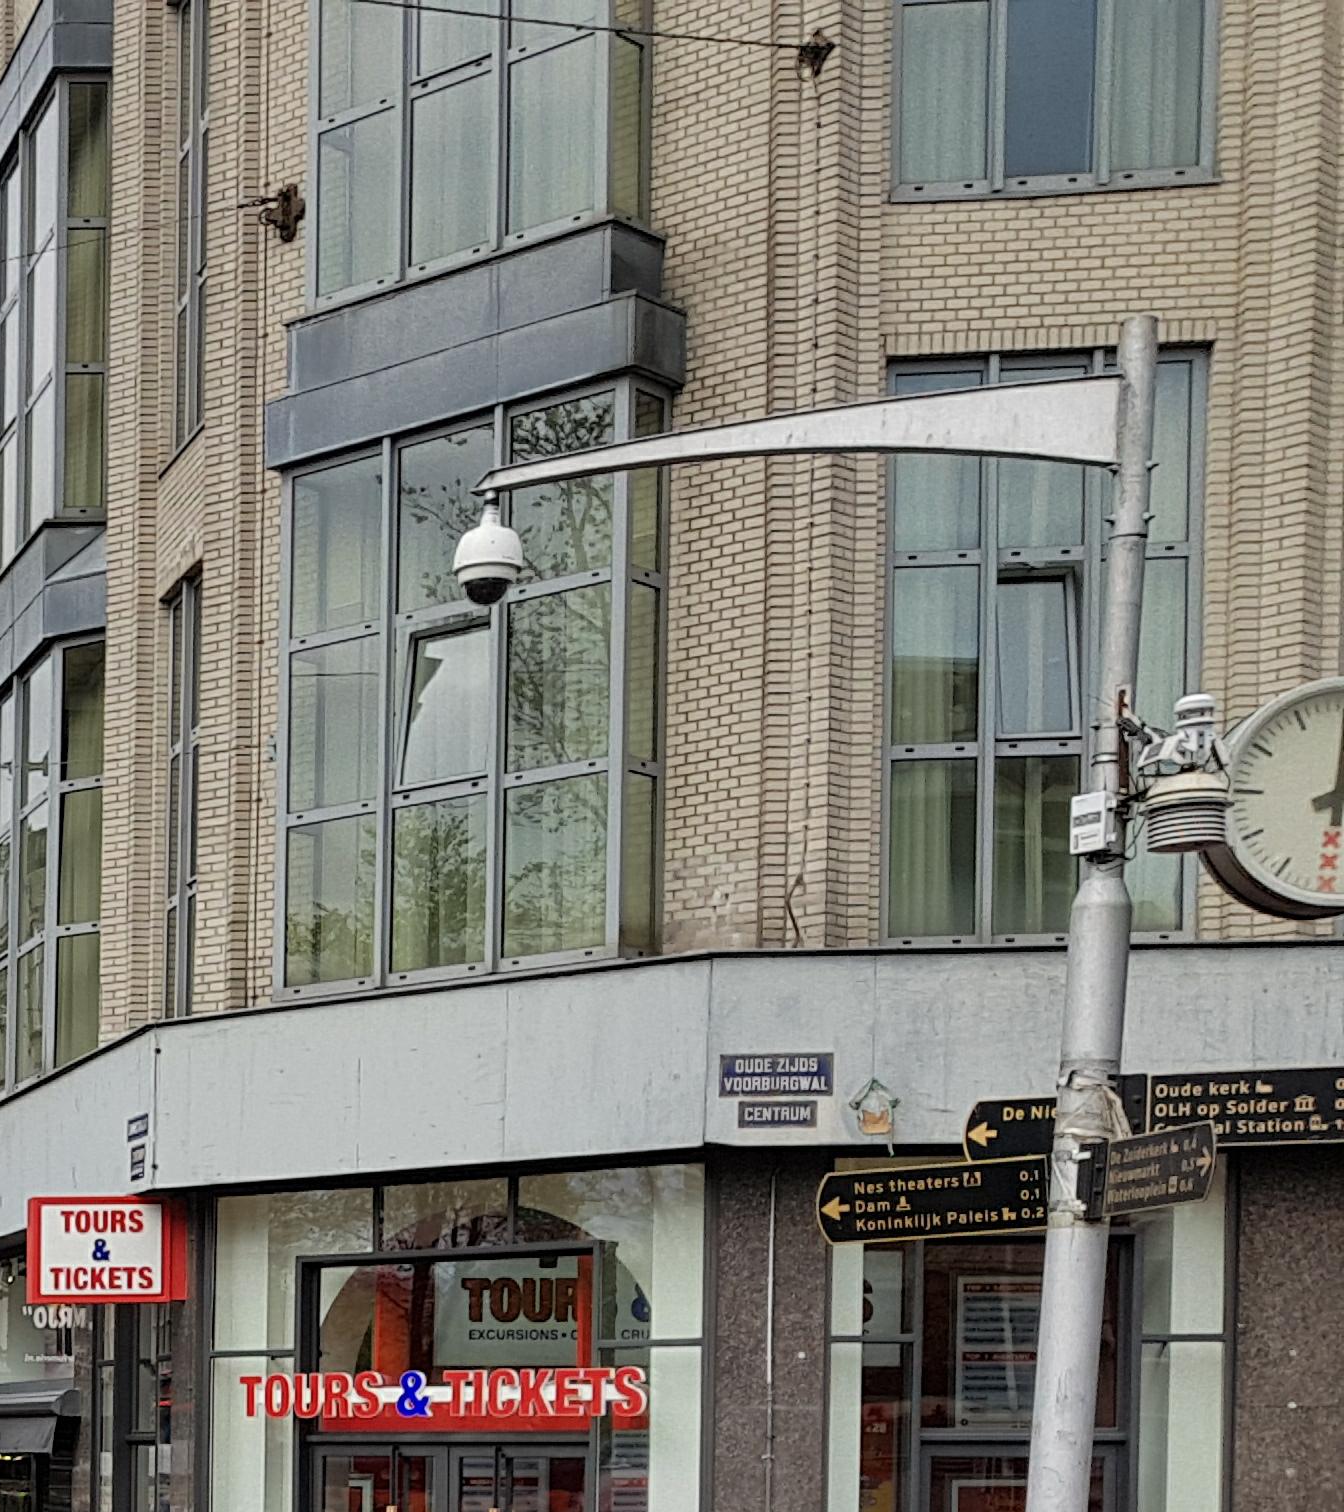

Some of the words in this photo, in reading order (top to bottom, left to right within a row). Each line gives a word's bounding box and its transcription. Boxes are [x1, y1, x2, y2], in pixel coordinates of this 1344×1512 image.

[735, 1058, 772, 1073] OUDE
[776, 1057, 818, 1072] ZIJDS
[724, 1076, 828, 1092] VOORBURGWAL
[1155, 1084, 1202, 1099] Oude
[1209, 1081, 1249, 1096] kerk
[744, 1105, 811, 1121] CENTRUM
[1003, 1106, 1023, 1121] De
[1030, 1104, 1058, 1119] Nie
[1154, 1103, 1190, 1117] OLH
[1197, 1104, 1220, 1119] op
[1226, 1099, 1288, 1115] Solder
[1236, 1115, 1304, 1133] Station
[854, 1182, 884, 1195] Nes
[889, 1176, 959, 1193] theaters
[855, 1201, 891, 1214] Dam
[61, 1210, 144, 1233] TOURS
[856, 1213, 942, 1232] Koninklijk
[947, 1209, 998, 1225] Paleis
[92, 1238, 110, 1261] &
[50, 1266, 154, 1290] TICKETS
[462, 1278, 578, 1322] TOUR
[469, 1330, 559, 1340] EXCURSIONS
[240, 1372, 384, 1419] TOURS
[396, 1370, 432, 1418] &
[442, 1366, 648, 1418] TICKETS
